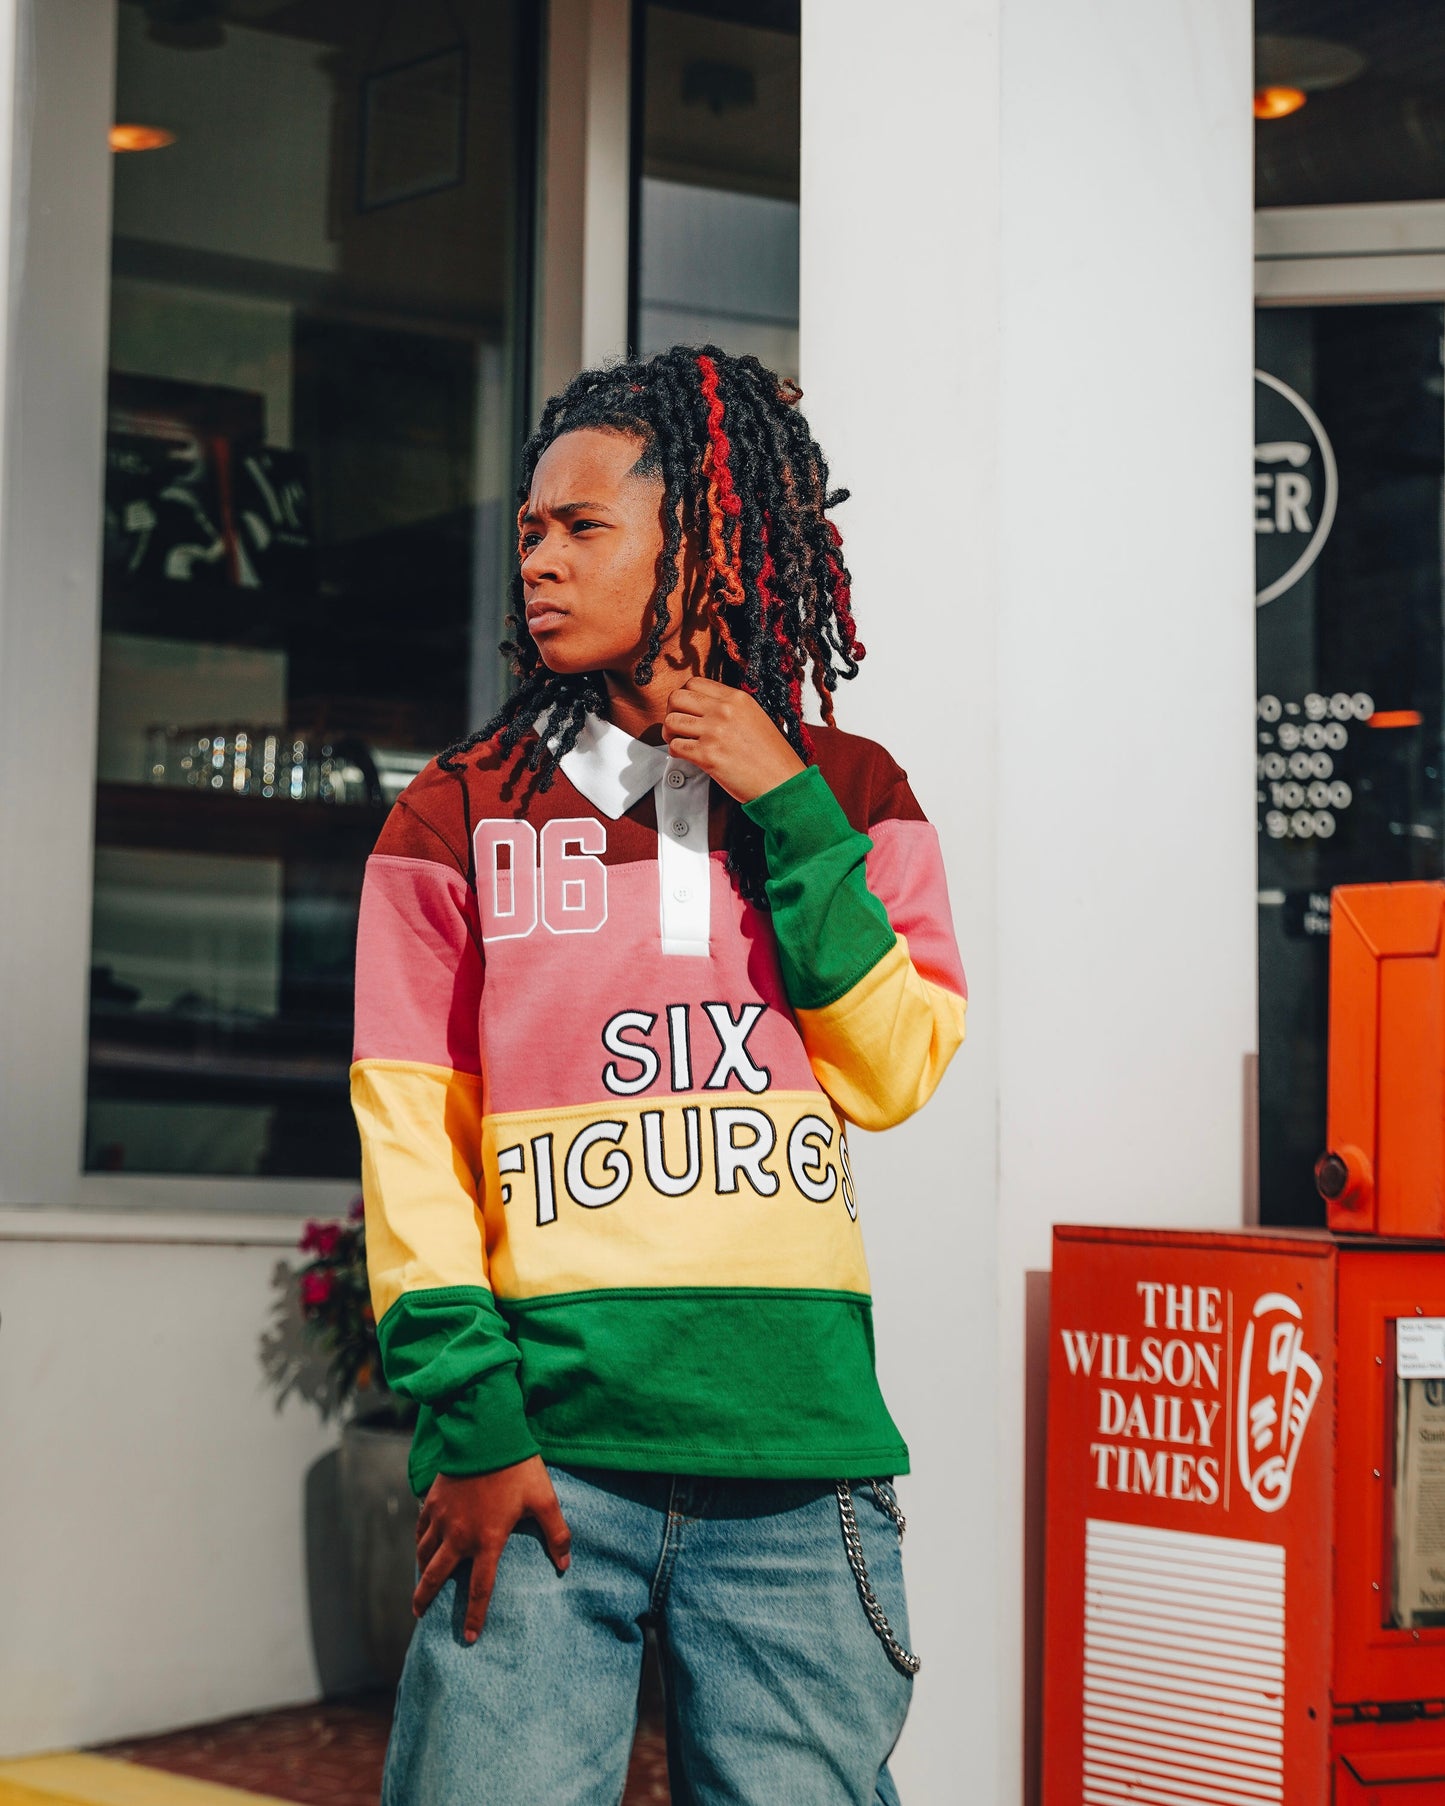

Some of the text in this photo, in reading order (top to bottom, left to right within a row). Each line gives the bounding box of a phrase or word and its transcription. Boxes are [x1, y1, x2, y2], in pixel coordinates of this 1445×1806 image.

[1304, 692, 1374, 721] 9:00
[1277, 722, 1348, 751] 9:00
[1268, 780, 1352, 809] 10:00
[1265, 809, 1336, 838] 9:00
[473, 817, 607, 943] 06
[601, 1001, 771, 1096] SIX
[1136, 1281, 1223, 1334] THE
[1061, 1329, 1222, 1390] WILSON
[1097, 1388, 1221, 1447] DAILY
[1090, 1443, 1220, 1505] TIMES
